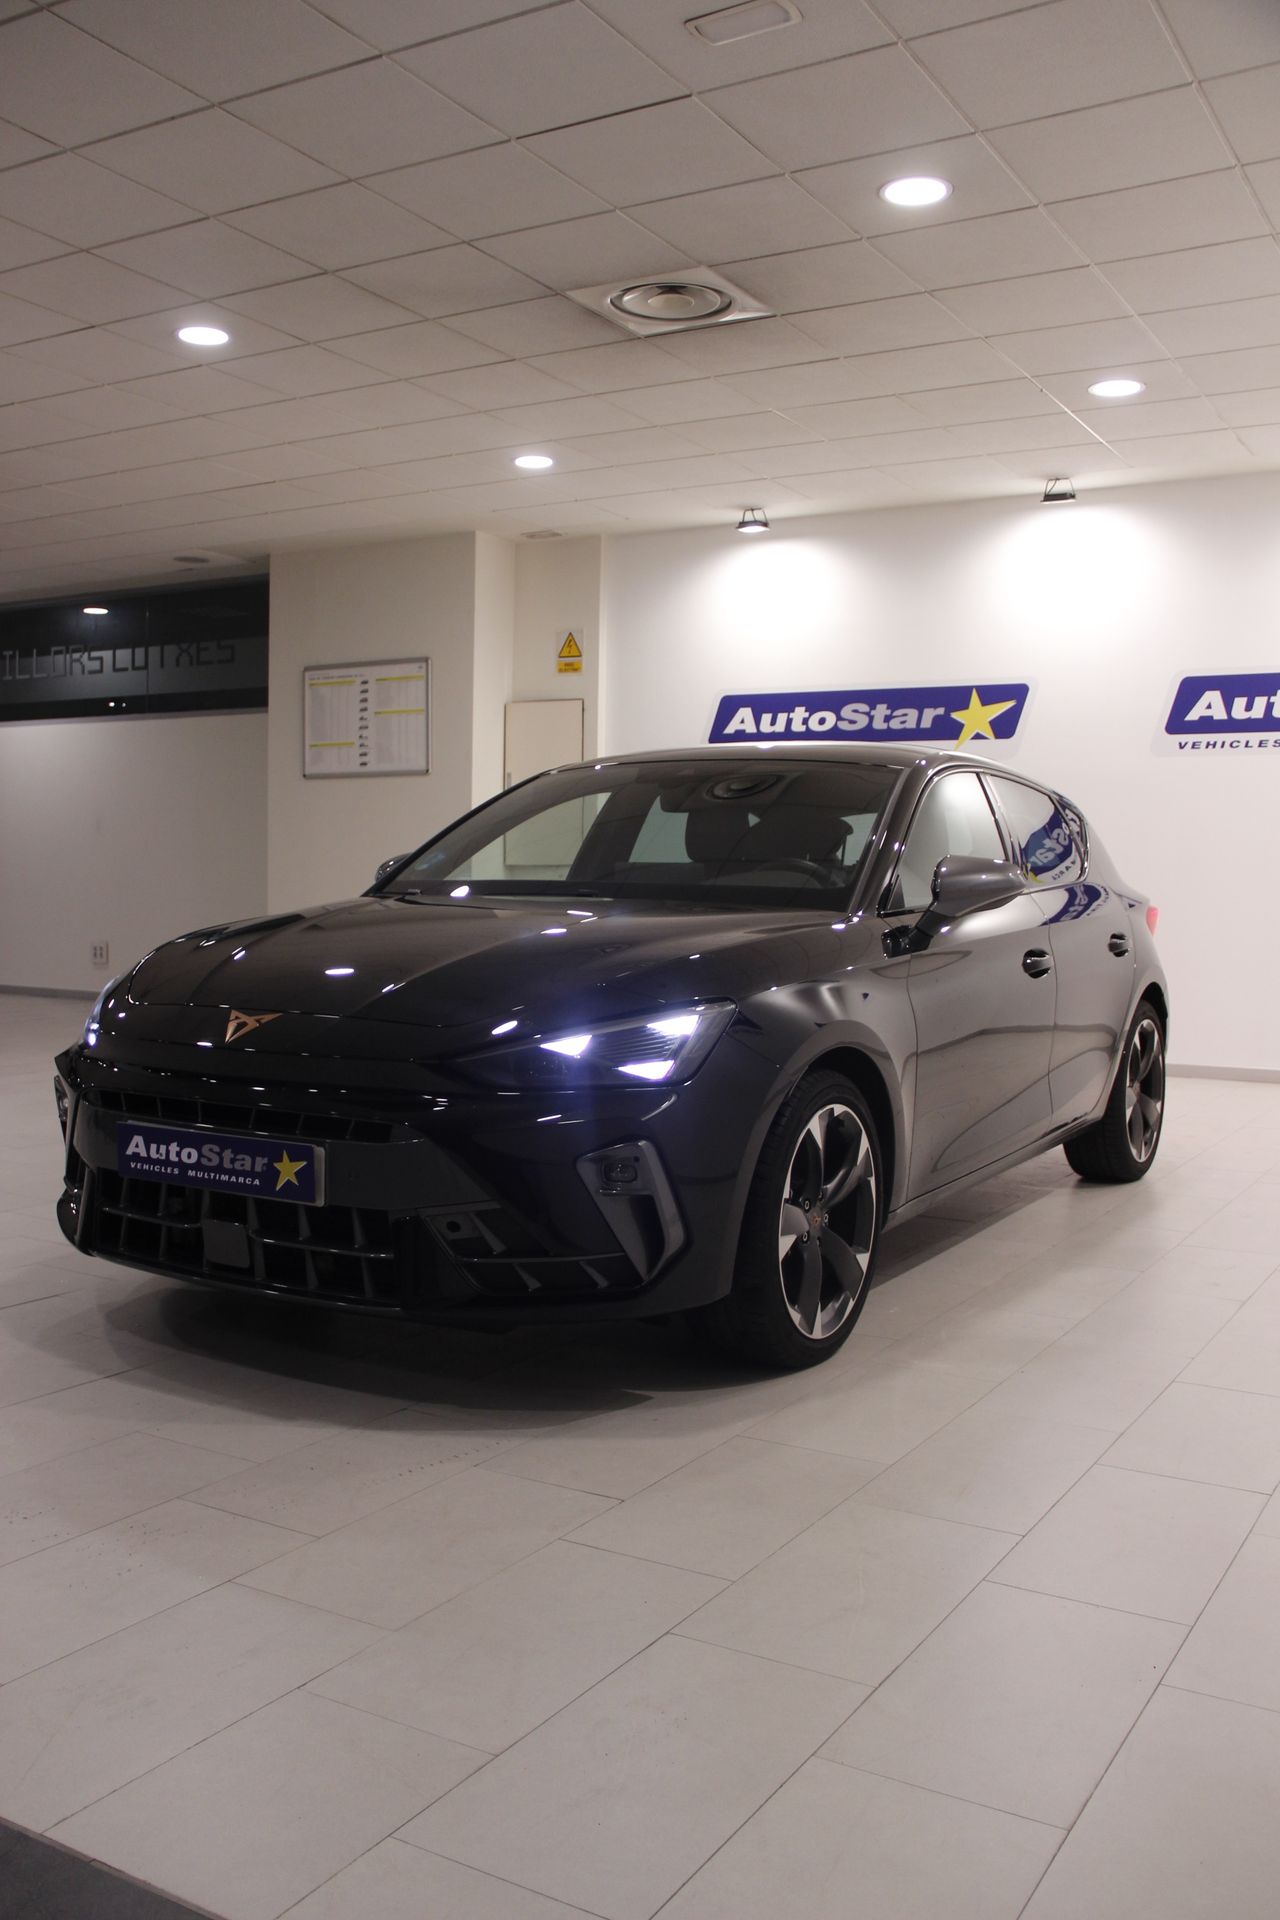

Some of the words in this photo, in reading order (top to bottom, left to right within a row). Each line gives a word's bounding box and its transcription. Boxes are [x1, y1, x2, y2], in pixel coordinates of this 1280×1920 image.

[723, 702, 945, 735] AutoStar
[1178, 738, 1280, 750] VEHICLES
[125, 1134, 268, 1173] AutoStar
[130, 1162, 180, 1175] VEHICLES
[187, 1169, 261, 1186] MULTIMARCA
